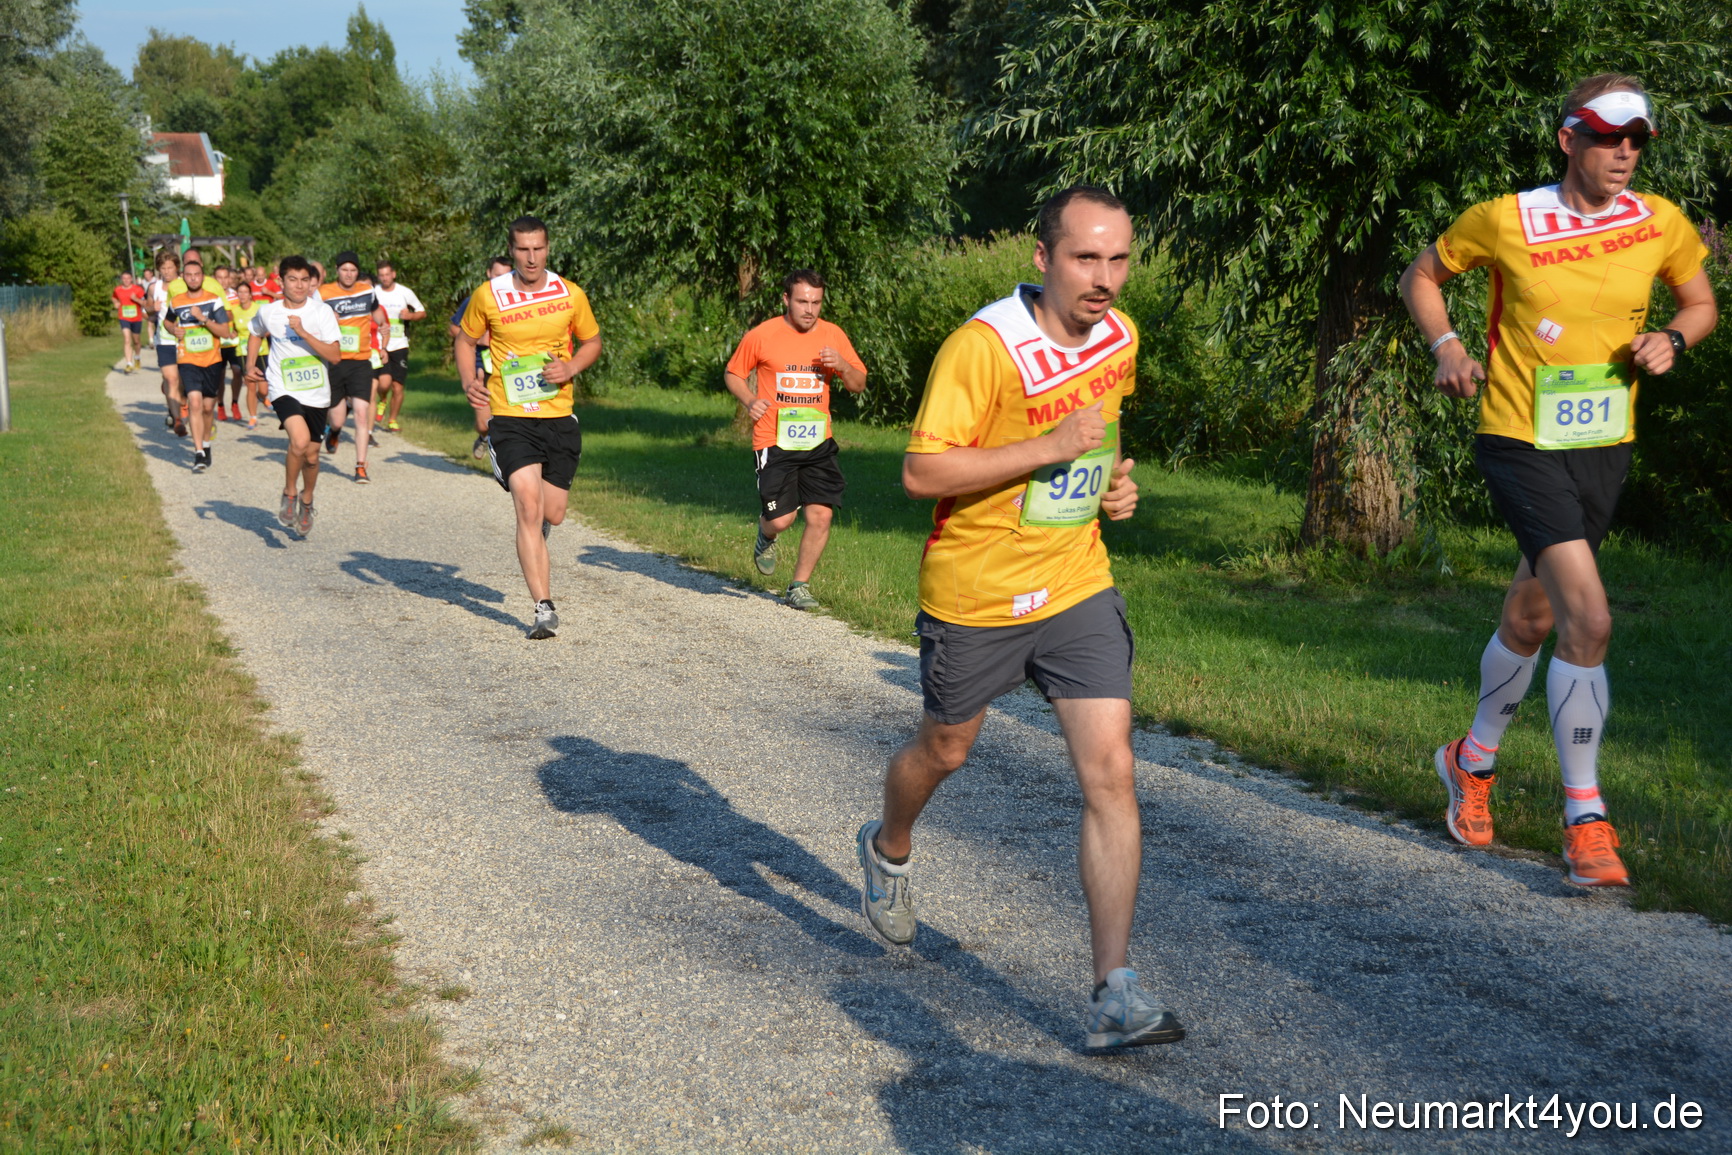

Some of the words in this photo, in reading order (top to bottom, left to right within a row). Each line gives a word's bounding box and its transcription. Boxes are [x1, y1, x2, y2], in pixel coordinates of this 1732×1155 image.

[1529, 243, 1595, 269] MAX
[1600, 223, 1663, 255] BÖGL
[501, 310, 534, 326] MAX
[538, 301, 573, 317] BÖGL
[190, 336, 208, 346] 449
[341, 336, 354, 346] 50
[286, 368, 320, 383] 1305
[785, 364, 797, 373] 30
[780, 376, 821, 390] OBI
[1026, 387, 1086, 427] MAX
[1556, 396, 1611, 427] 881
[787, 424, 817, 439] 624
[1048, 464, 1103, 501] 920
[767, 500, 777, 512] SF
